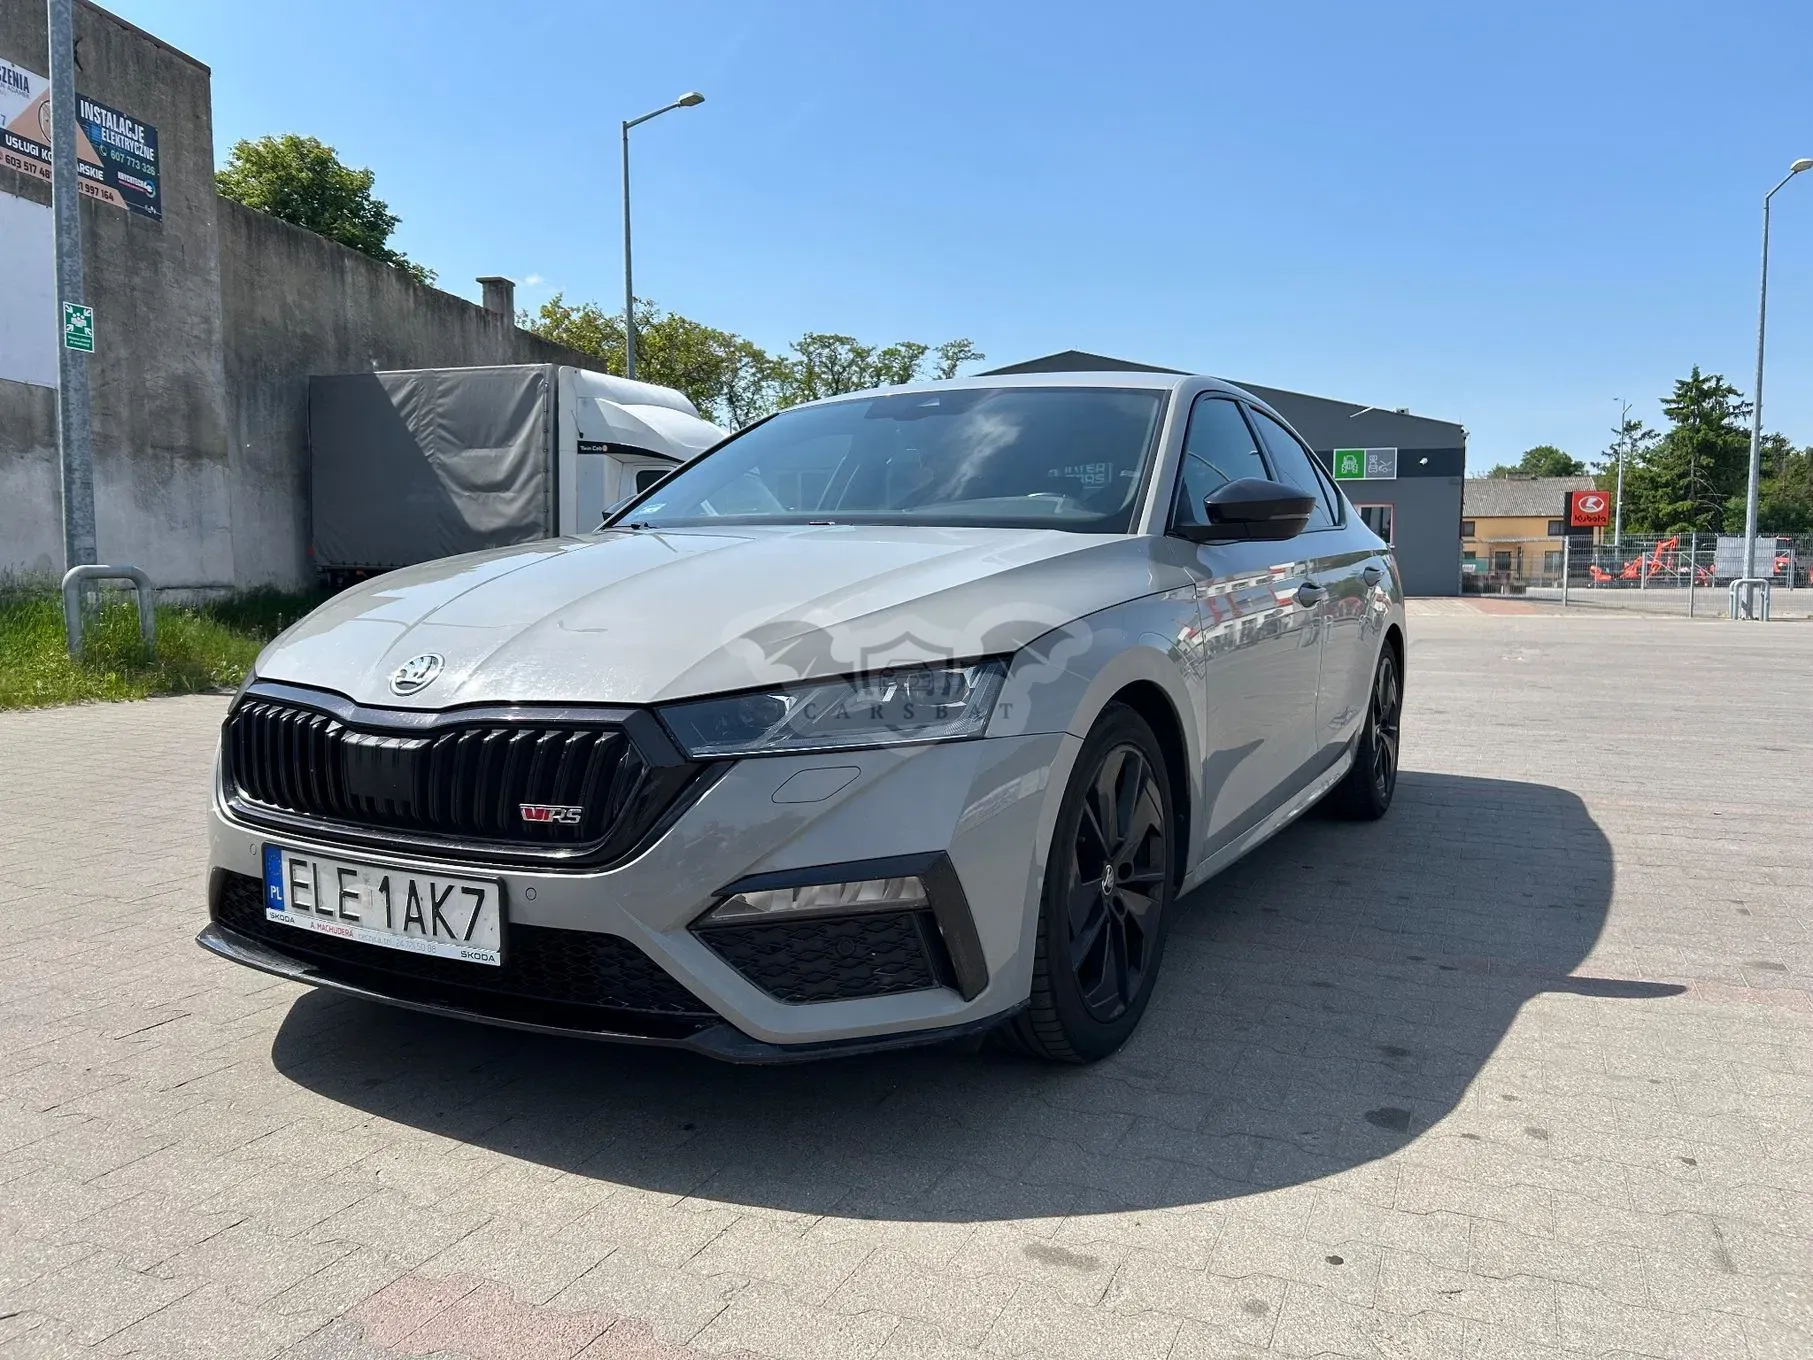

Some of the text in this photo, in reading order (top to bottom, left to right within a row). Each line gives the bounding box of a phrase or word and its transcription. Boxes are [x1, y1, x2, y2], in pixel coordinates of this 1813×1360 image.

[0, 65, 30, 94] ZENIA
[80, 100, 145, 144] INSTALACJE
[101, 127, 155, 161] ELEKTRYCZNE
[5, 154, 21, 168] 603
[24, 161, 37, 174] 517
[40, 167, 52, 179] 48
[85, 184, 99, 196] 997
[110, 150, 125, 163] 607
[126, 155, 140, 170] 773
[1574, 514, 1606, 523] Kubota
[270, 885, 282, 900] PL
[289, 857, 485, 941] ELE 1AK7
